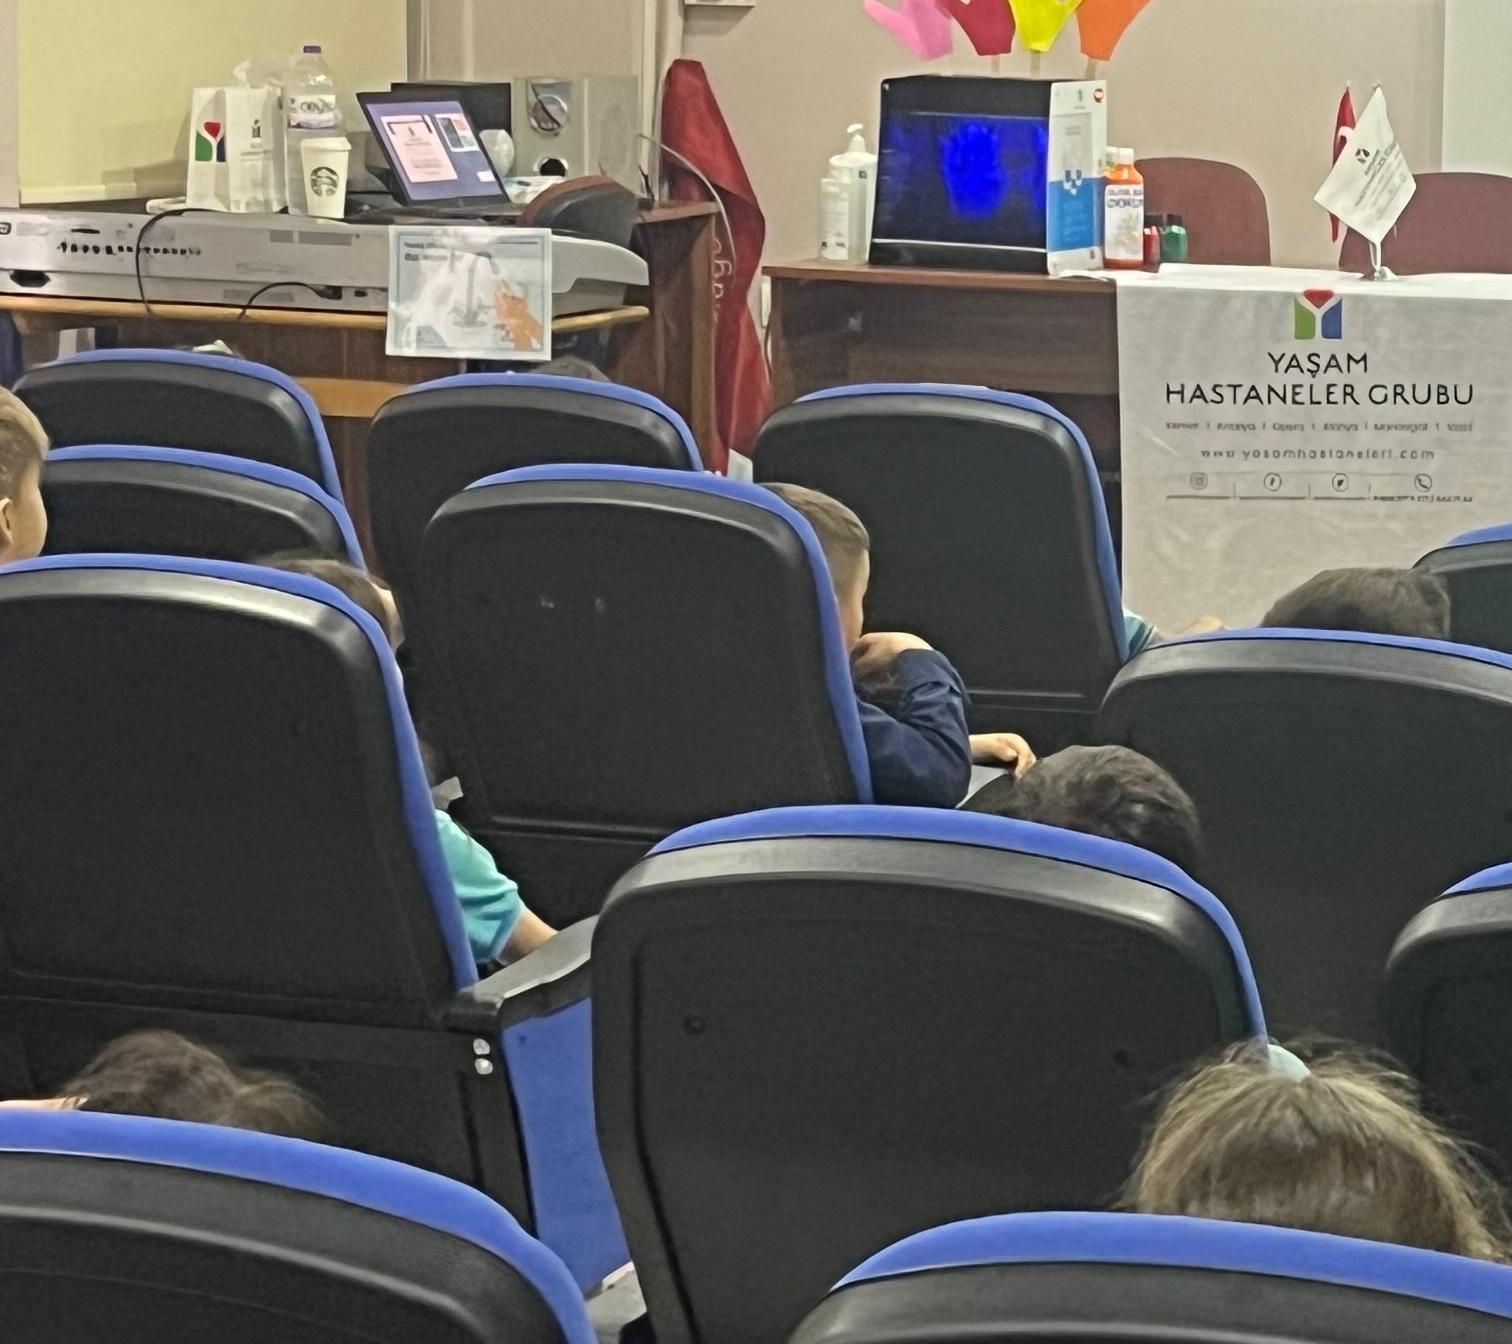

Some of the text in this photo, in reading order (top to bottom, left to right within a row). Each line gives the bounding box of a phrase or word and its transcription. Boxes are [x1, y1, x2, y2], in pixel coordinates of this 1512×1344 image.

[1267, 351, 1368, 379] YAŞAM
[1166, 382, 1473, 406] HASTANELER GRUBU
[1200, 448, 1435, 461] wwwyasamhastanelericom
